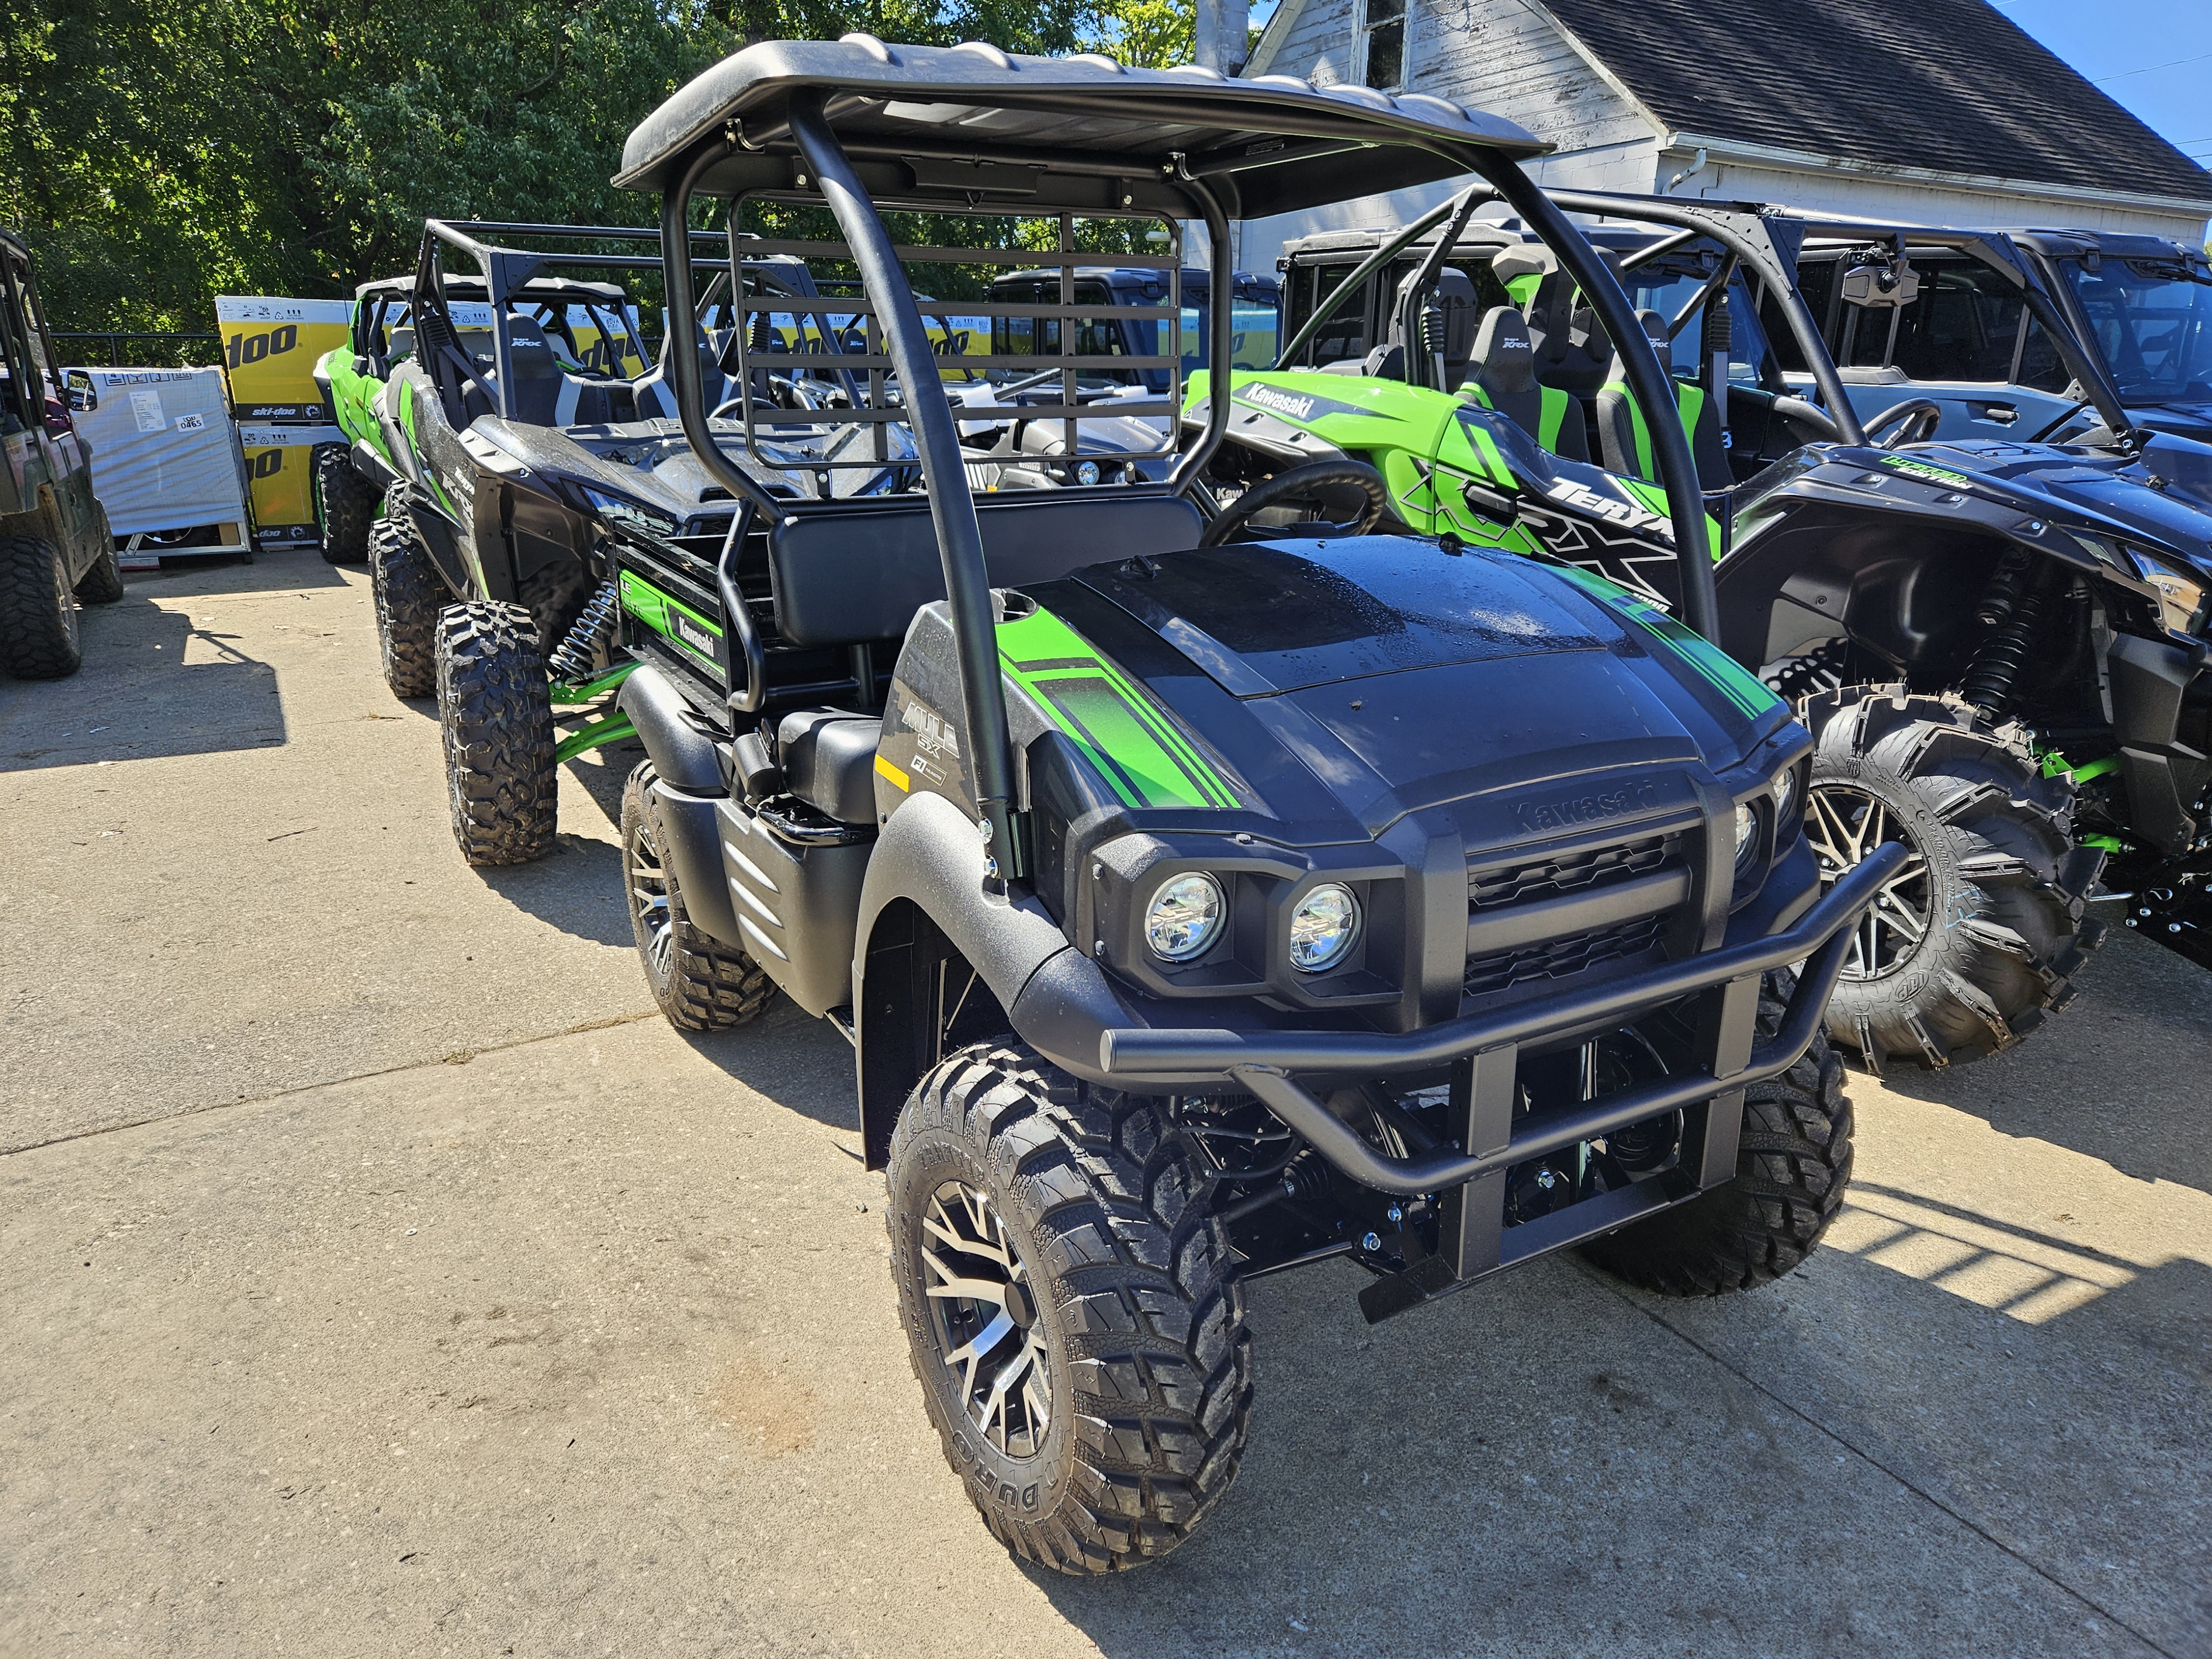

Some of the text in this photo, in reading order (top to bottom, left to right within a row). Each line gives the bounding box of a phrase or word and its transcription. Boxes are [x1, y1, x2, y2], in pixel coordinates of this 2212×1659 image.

[252, 408, 297, 416] ski-doo
[1245, 382, 1315, 419] Kawasaki
[180, 420, 202, 430] 0465
[1896, 467, 1974, 490] EDITION
[620, 578, 631, 596] LE
[678, 615, 714, 658] Kawasaki
[901, 700, 960, 759] MULE
[917, 733, 941, 760] SX
[914, 758, 925, 770] FI
[1505, 780, 1661, 837] Kawasaki
[1898, 972, 1924, 1001] ITP
[952, 1430, 1039, 1512] DURO
